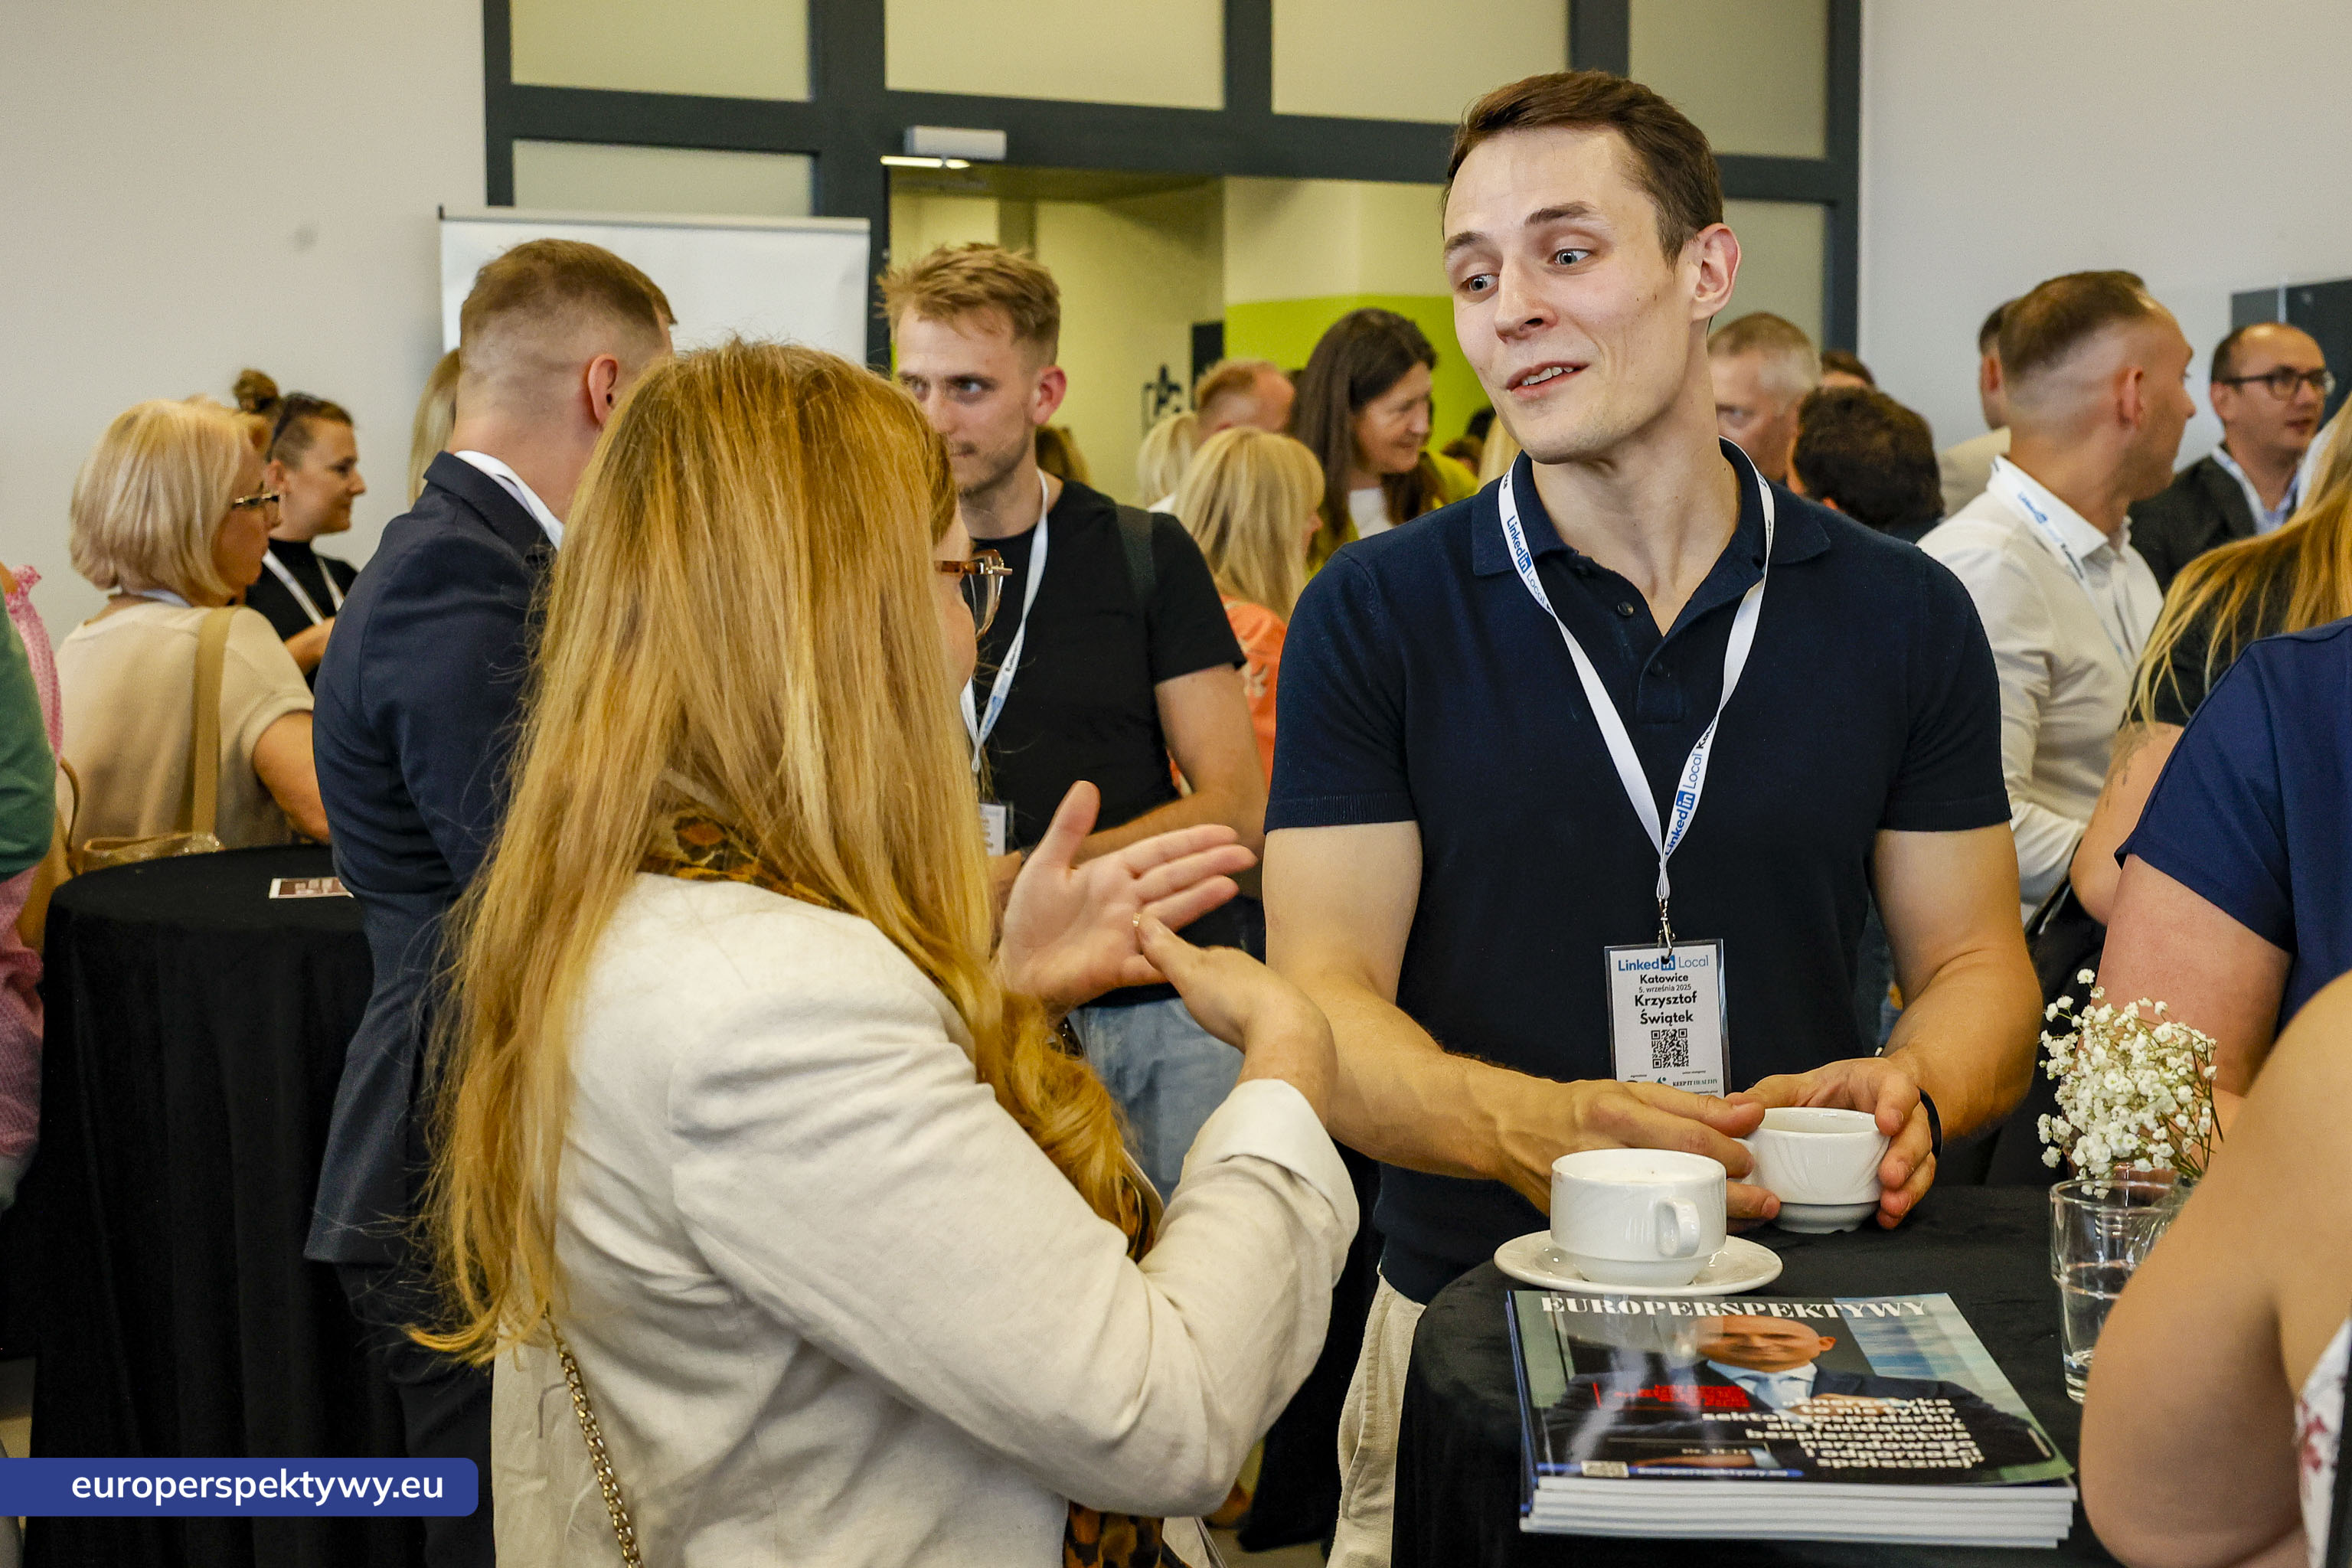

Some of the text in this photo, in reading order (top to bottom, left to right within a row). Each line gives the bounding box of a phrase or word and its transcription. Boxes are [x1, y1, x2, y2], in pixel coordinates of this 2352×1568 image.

[1507, 515, 1532, 574] Linkedin
[1527, 570, 1546, 605] Local
[1684, 753, 1703, 789] Local
[1678, 955, 1709, 968] Local
[1640, 972, 1689, 985] Katowice
[1646, 984, 1674, 993] września
[1635, 991, 1697, 1008] Krzysztof
[1640, 1008, 1694, 1027] Świątek
[1541, 1296, 1926, 1318] EUROPERSPEKTYWY
